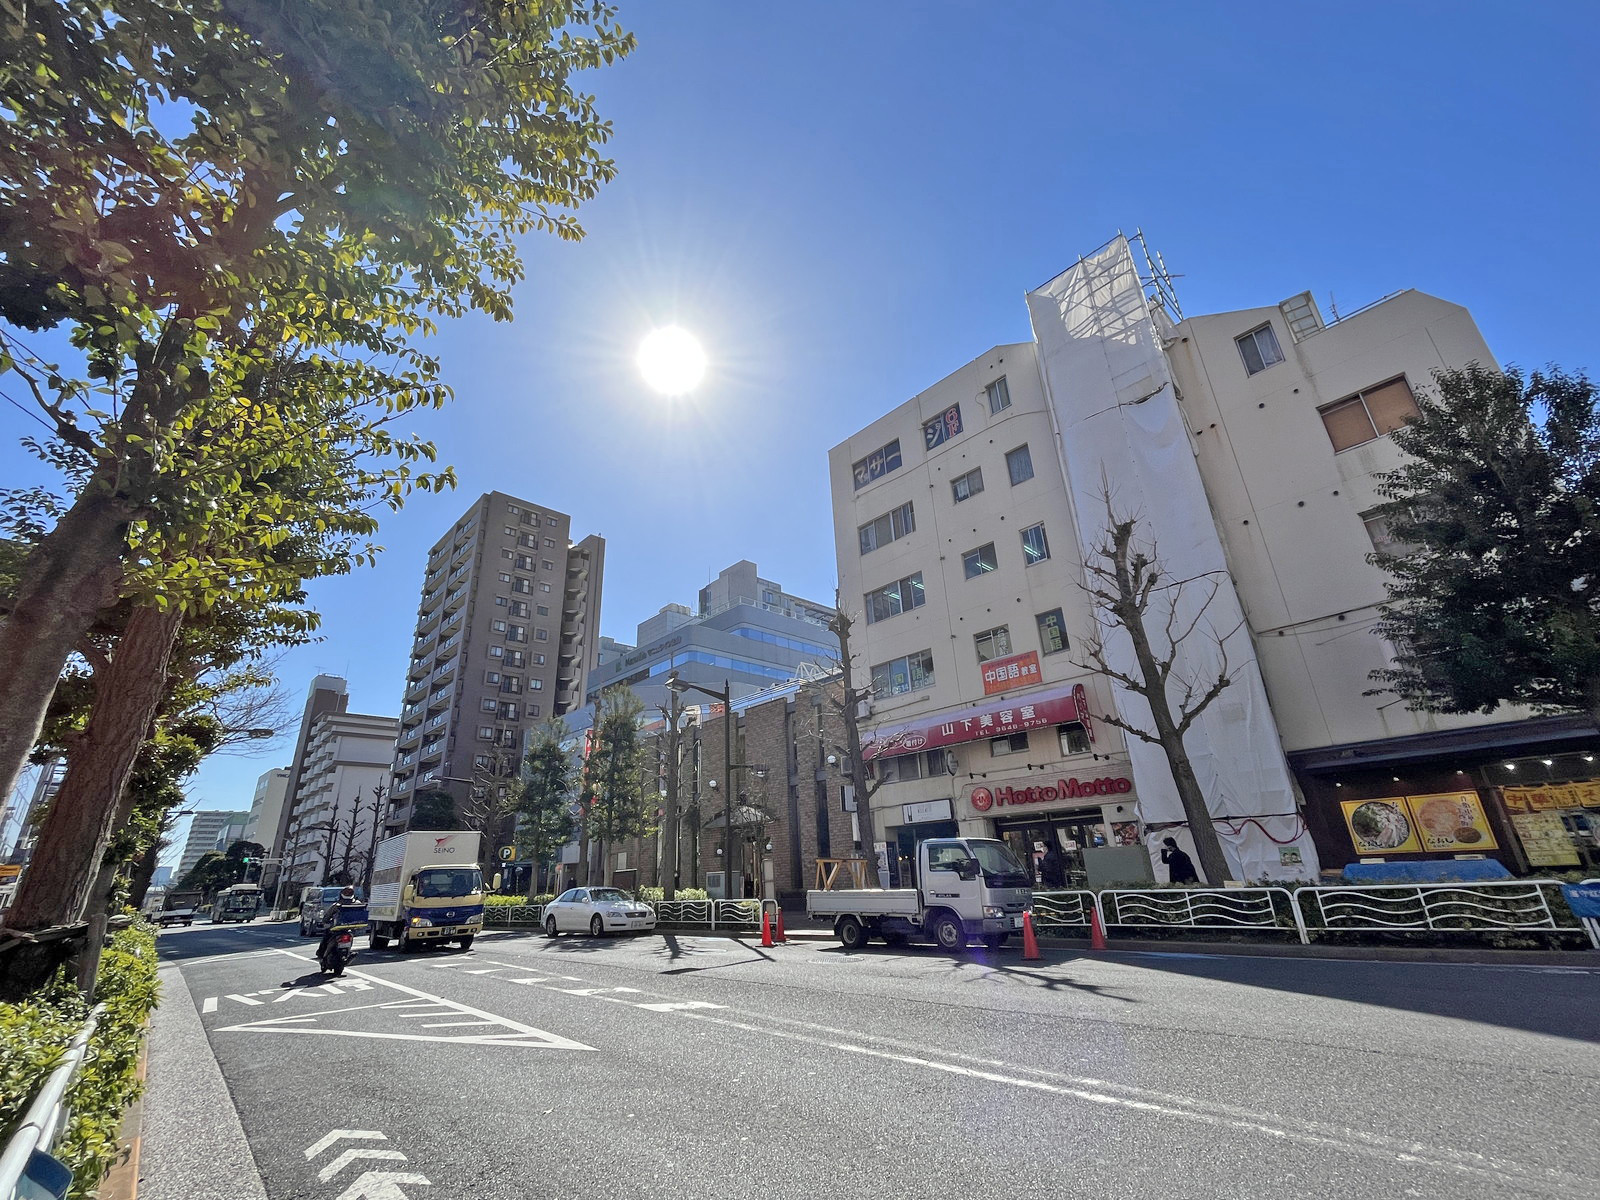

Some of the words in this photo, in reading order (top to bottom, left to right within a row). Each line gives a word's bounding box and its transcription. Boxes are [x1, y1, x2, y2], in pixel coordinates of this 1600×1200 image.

[941, 705, 1035, 737] 山下美容室
